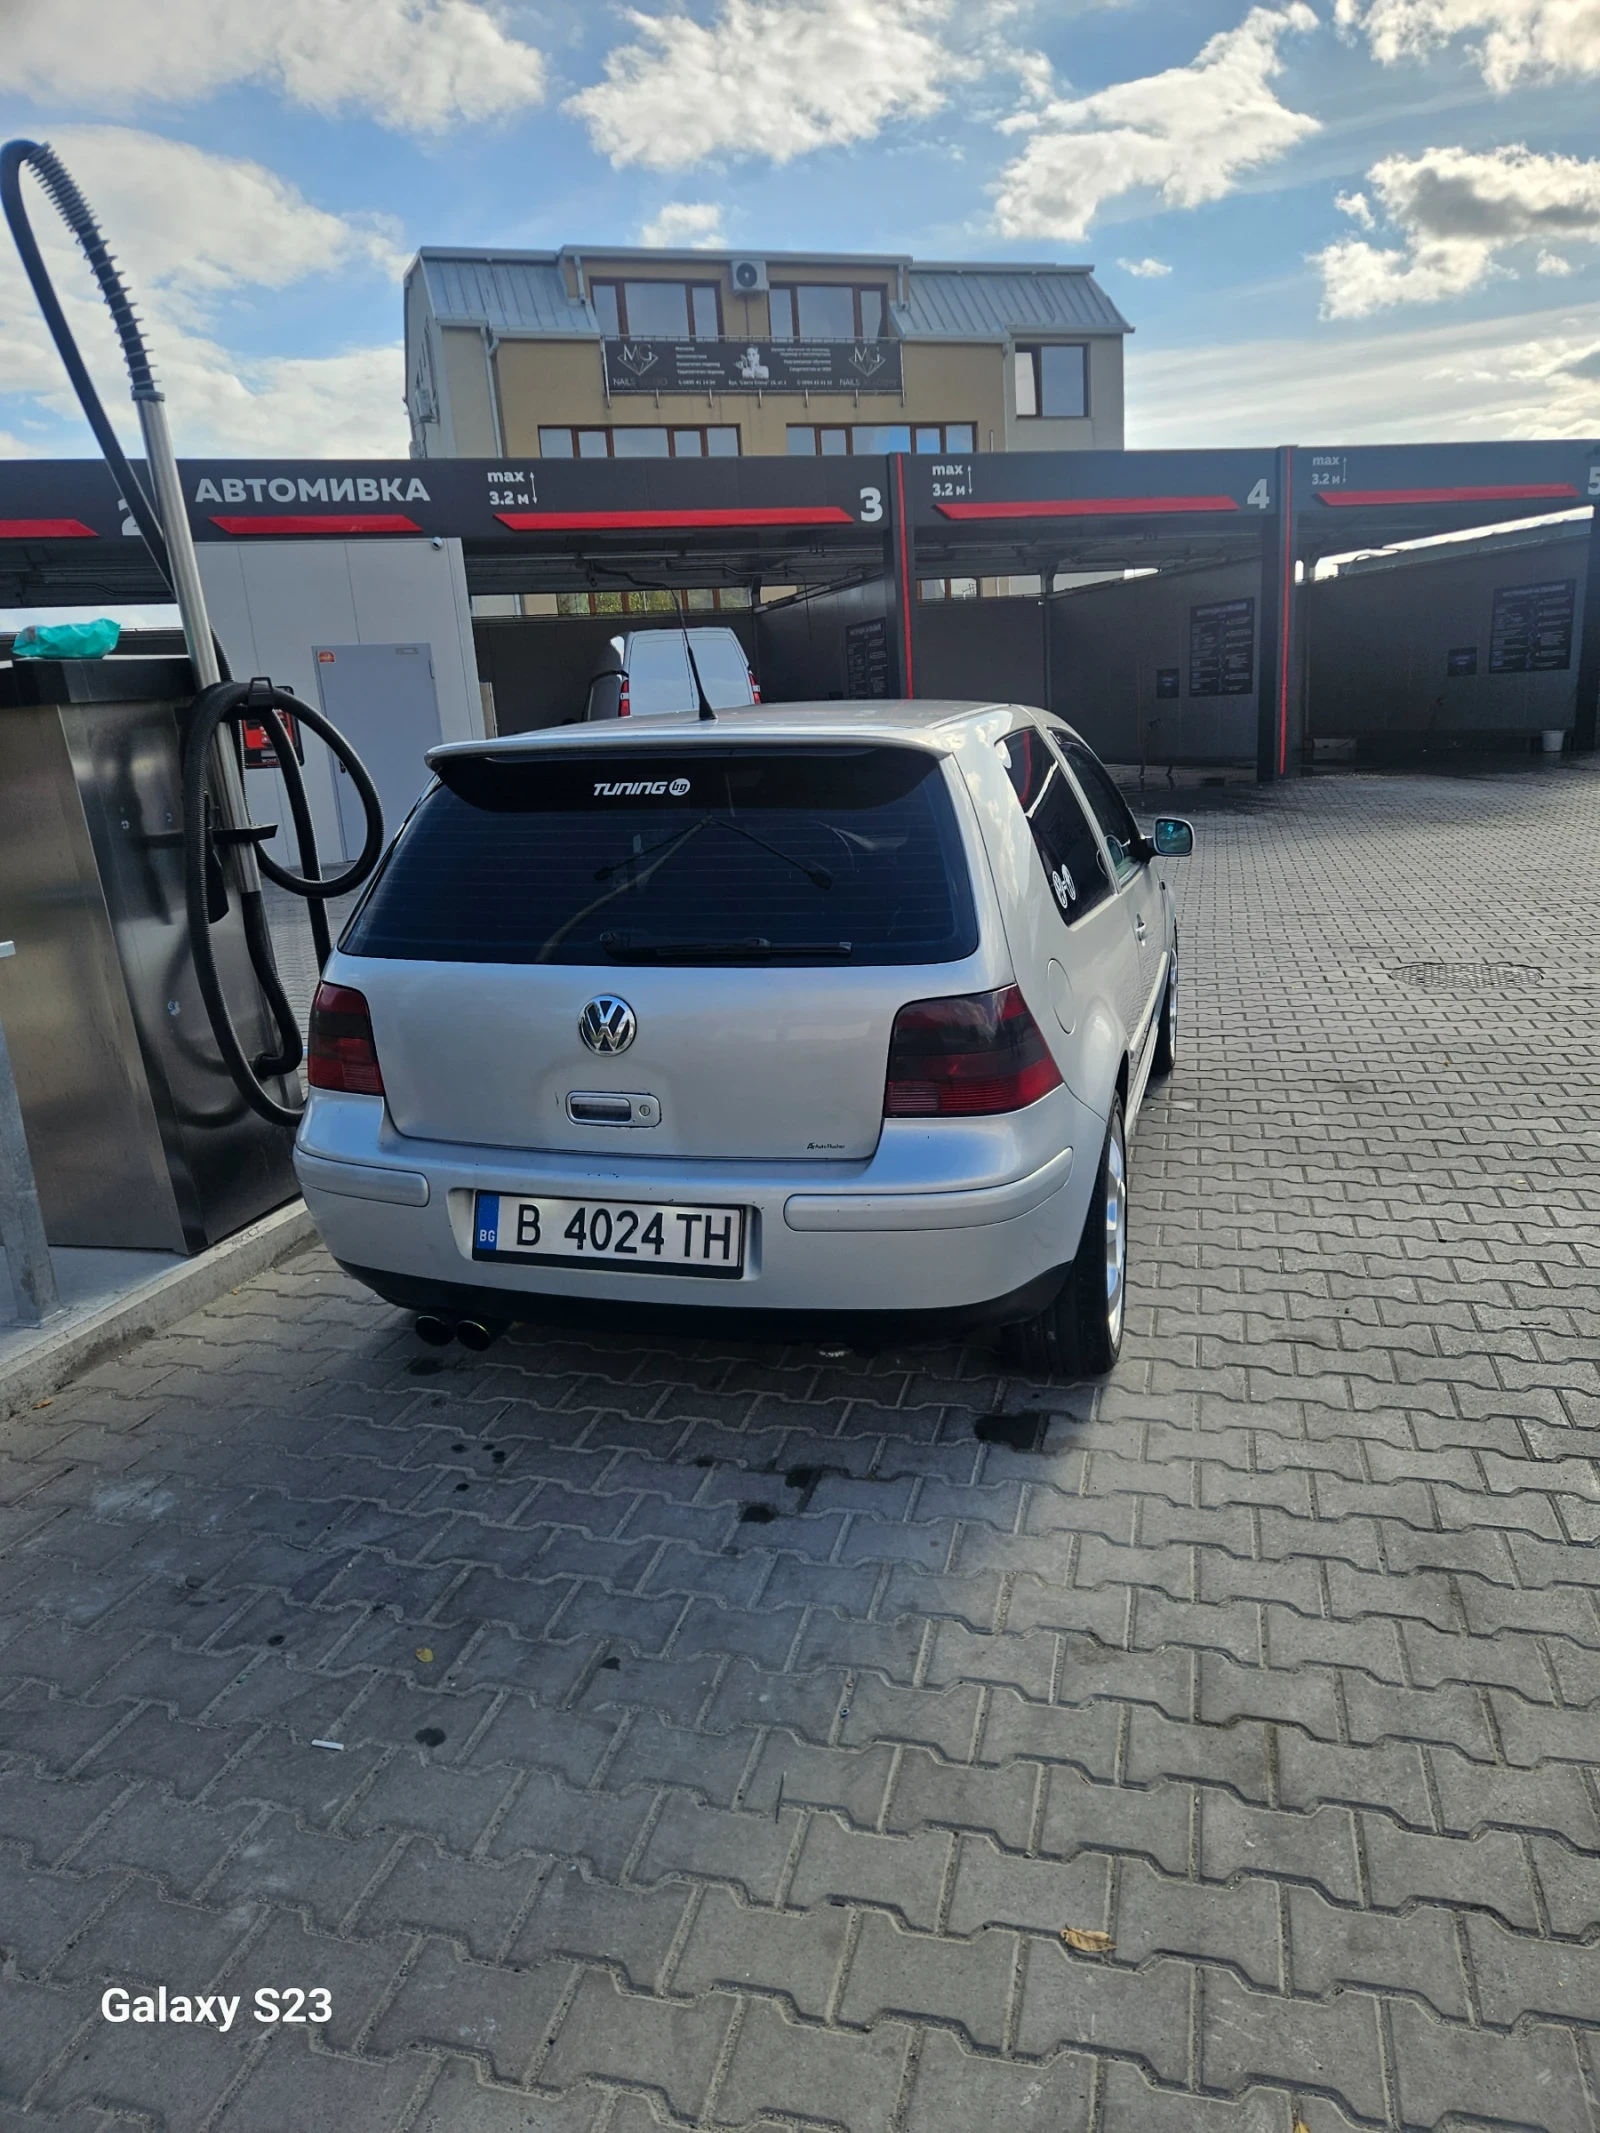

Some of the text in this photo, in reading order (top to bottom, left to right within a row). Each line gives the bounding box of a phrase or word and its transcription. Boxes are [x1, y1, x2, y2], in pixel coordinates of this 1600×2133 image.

[1312, 455, 1340, 466] max
[487, 471, 525, 482] max
[932, 464, 963, 476] max
[1311, 473, 1330, 485] 3.2
[195, 477, 431, 503] АВТОМИВКА
[932, 482, 953, 497] 3.2
[1246, 478, 1270, 509] 4
[489, 490, 514, 505] 3.2
[860, 487, 883, 522] 3
[593, 781, 668, 796] TUNING
[479, 1203, 732, 1260] BG B 4024 TH
